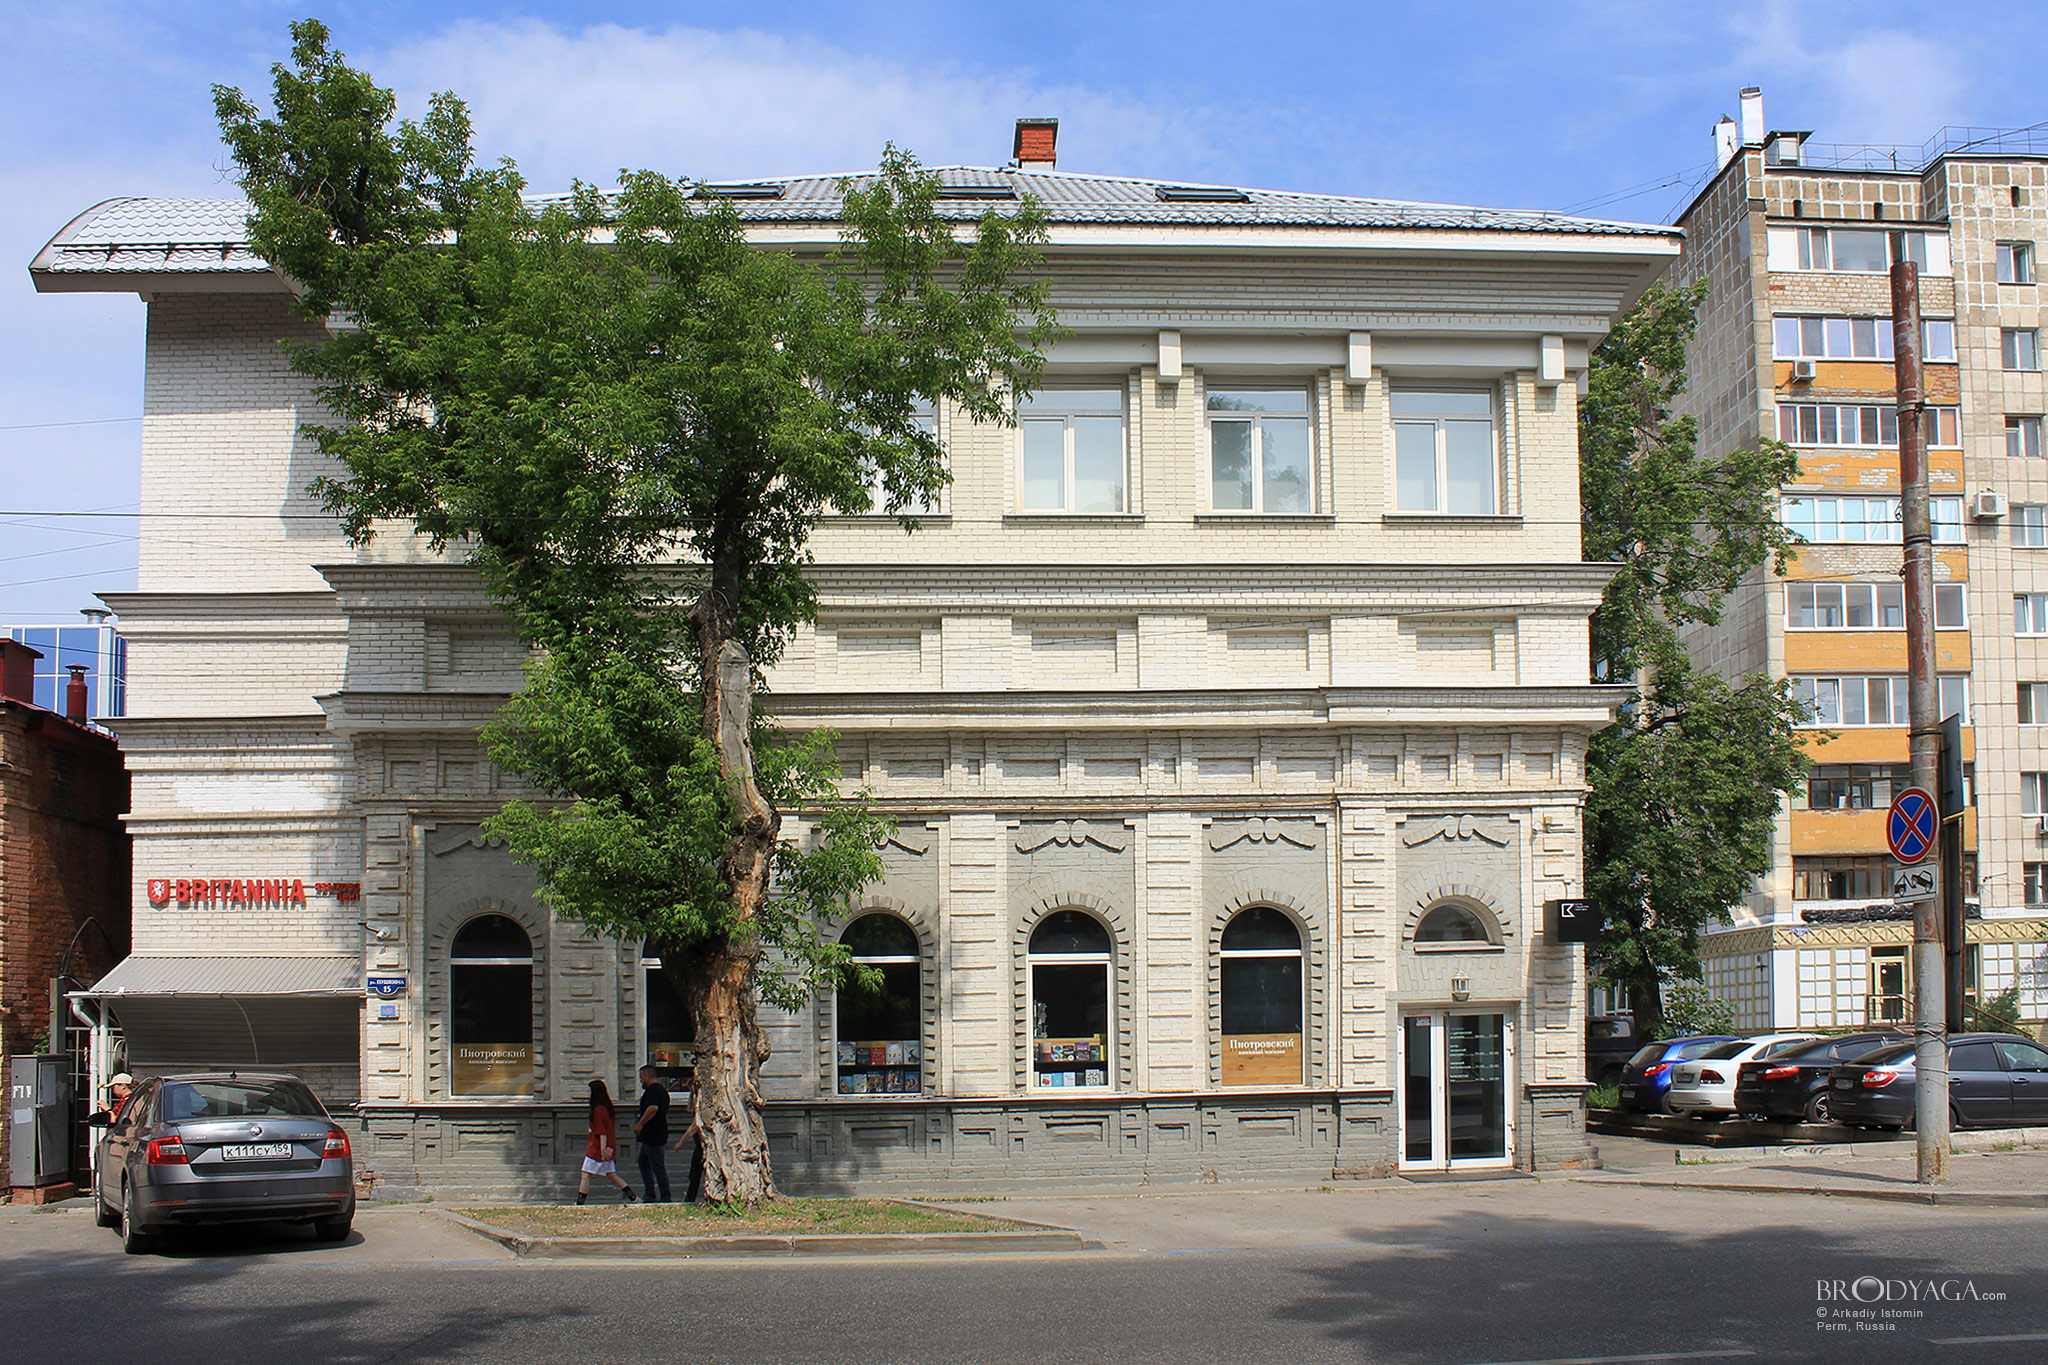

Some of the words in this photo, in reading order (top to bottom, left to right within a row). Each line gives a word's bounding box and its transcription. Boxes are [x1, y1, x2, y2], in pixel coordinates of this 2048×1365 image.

[176, 879, 306, 903] BRITANNIA
[383, 985, 391, 993] 15
[1229, 1037, 1294, 1051] Пиотровский
[460, 1048, 526, 1060] Пиотровский
